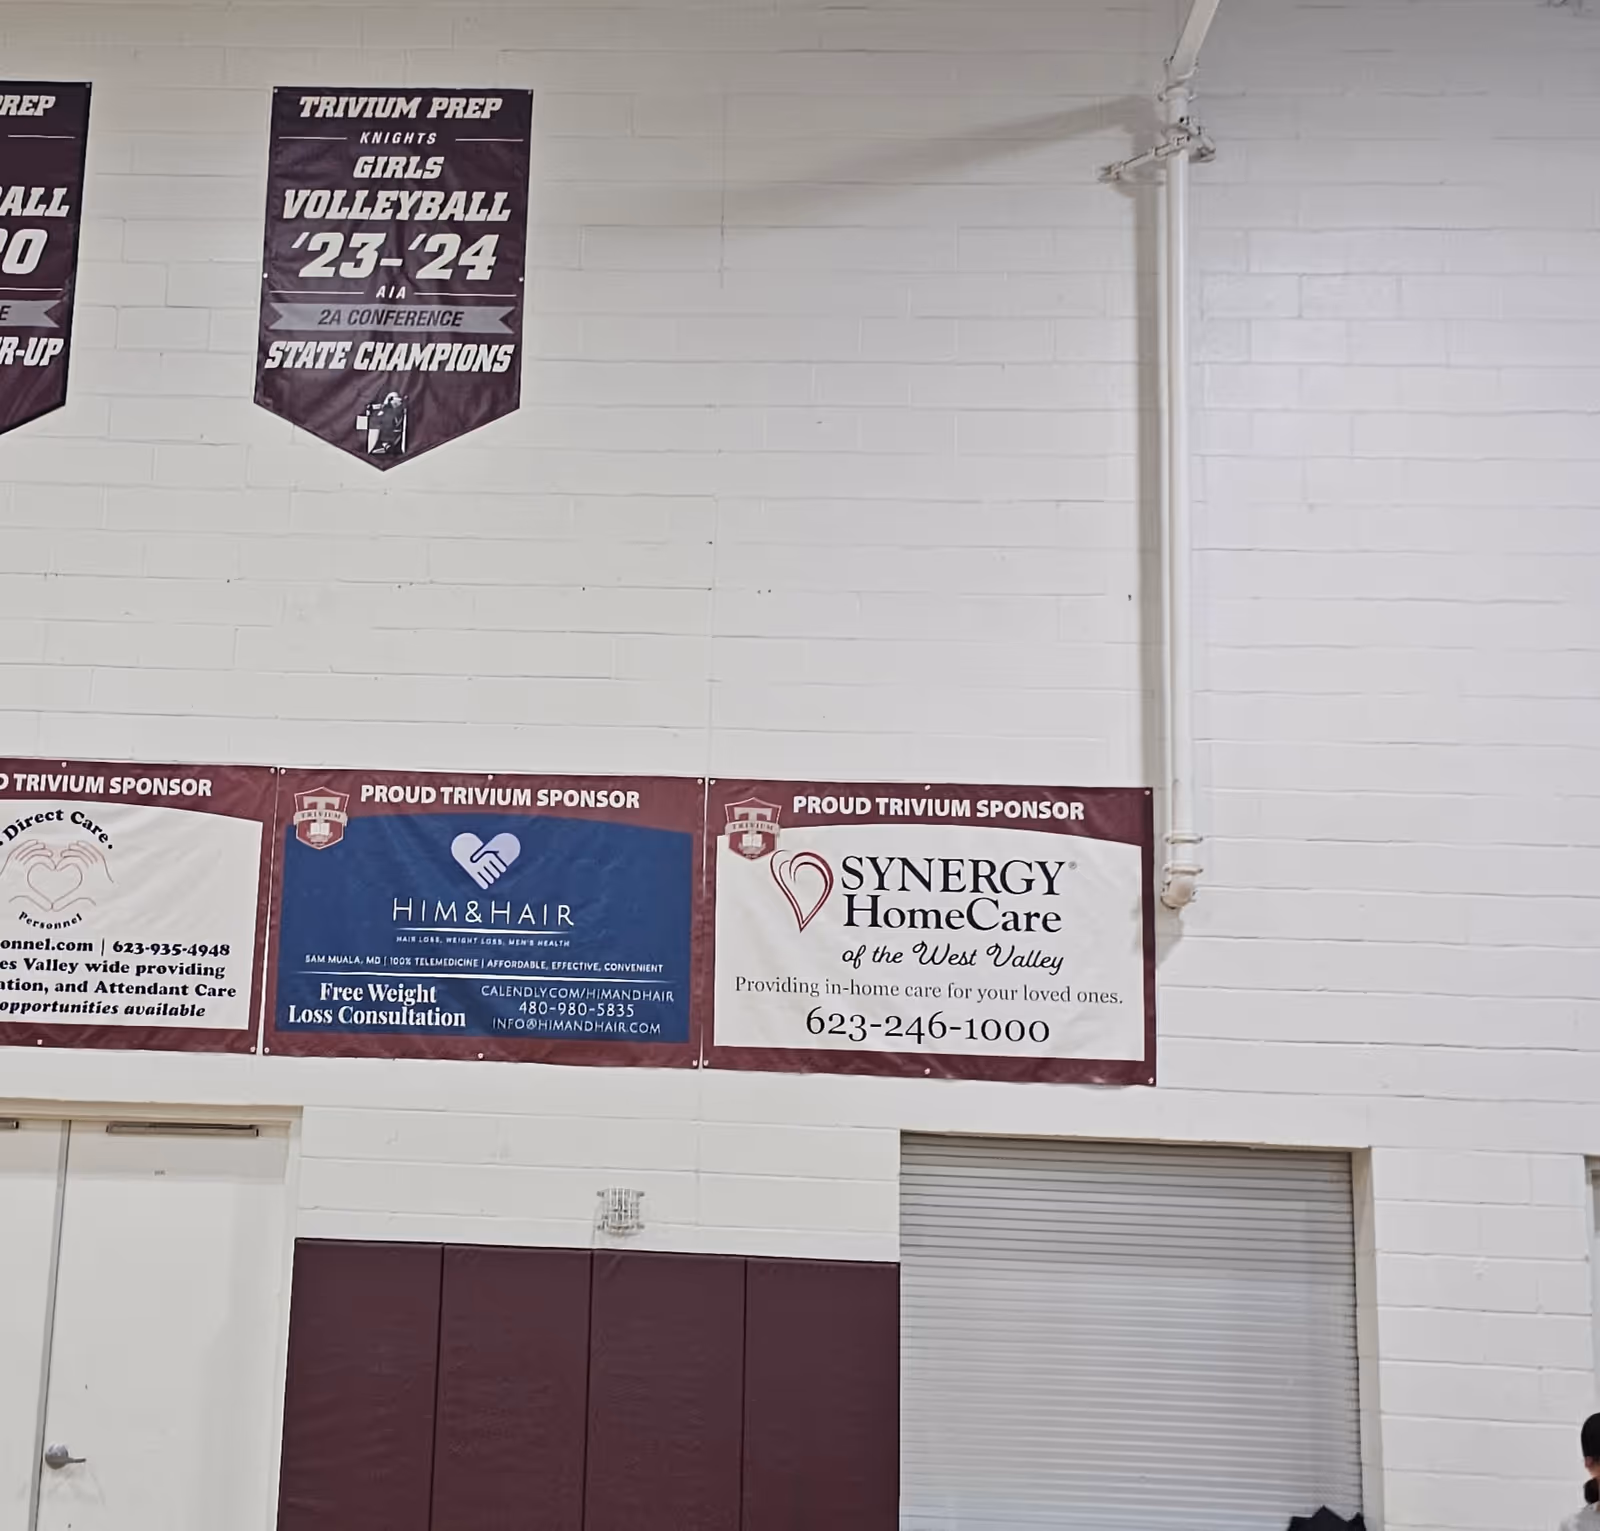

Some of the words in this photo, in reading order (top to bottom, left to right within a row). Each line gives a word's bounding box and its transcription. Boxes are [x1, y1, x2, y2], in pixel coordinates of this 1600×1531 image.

[299, 96, 422, 119] TRIVIUM
[426, 97, 503, 119] PREP
[359, 131, 438, 145] KNIGHTS
[353, 155, 445, 180] GIRLS
[0, 185, 70, 217] ALL
[283, 189, 512, 222] VOLLEYBALL
[376, 285, 407, 300] AIA
[318, 308, 342, 326] 2A
[347, 309, 465, 327] CONFERENCE
[0, 336, 64, 367] R-UP
[264, 340, 353, 370] STATE
[353, 341, 516, 373] CHAMPIONS
[13, 773, 105, 794] TRIVIUM
[109, 776, 213, 797] SPONSOR
[360, 784, 437, 804] PROUD
[440, 786, 532, 807] TRIVIUM
[536, 788, 640, 809] SPONSOR
[792, 795, 872, 815] PROUD
[875, 797, 972, 818] TRIVIUM
[976, 799, 1086, 820] SPONSOR
[2, 808, 64, 842] Direct
[18, 910, 83, 930] Personnel
[392, 897, 575, 926] HIM&HAIR
[842, 893, 1063, 933] HomeCare
[0, 938, 93, 952] onnel.com
[112, 940, 230, 957] 623-935-4948
[396, 935, 416, 943] HAIR
[446, 937, 478, 945] WEIGHT
[508, 938, 534, 946] MEN'S
[537, 939, 570, 947] HEALTH
[23, 957, 79, 974] Valley
[84, 960, 130, 973] wide
[135, 962, 226, 980] providing
[305, 954, 325, 963] SAM
[328, 955, 364, 965] MUALA,
[366, 955, 381, 964] MD
[389, 956, 412, 966] 100%
[414, 957, 479, 968] TELEMEDICINE
[487, 959, 549, 970] AFFORDABLE,
[551, 961, 601, 972] EFFECTIVE,
[604, 962, 664, 973] CONVENIENT
[841, 944, 867, 969] of
[872, 945, 904, 963] the
[912, 940, 978, 966] West
[986, 942, 1064, 976] Valley
[54, 980, 88, 993] and
[94, 980, 190, 996] Attendant
[194, 983, 237, 998] Care
[319, 982, 364, 1001] Free
[367, 983, 437, 1006] Weight
[735, 976, 820, 997] Providing
[825, 978, 900, 997] in-home
[904, 985, 942, 998] care
[948, 982, 973, 999] for
[977, 988, 1018, 1003] your
[1023, 984, 1071, 1002] loved
[1077, 990, 1123, 1004] ones.
[0, 1000, 119, 1015] opportunities
[124, 1002, 206, 1017] available
[288, 1004, 333, 1024] Loss
[338, 1005, 467, 1028] Consultation
[518, 1001, 635, 1018] 480-980-5835
[806, 1006, 1050, 1045] 623-246-1000
